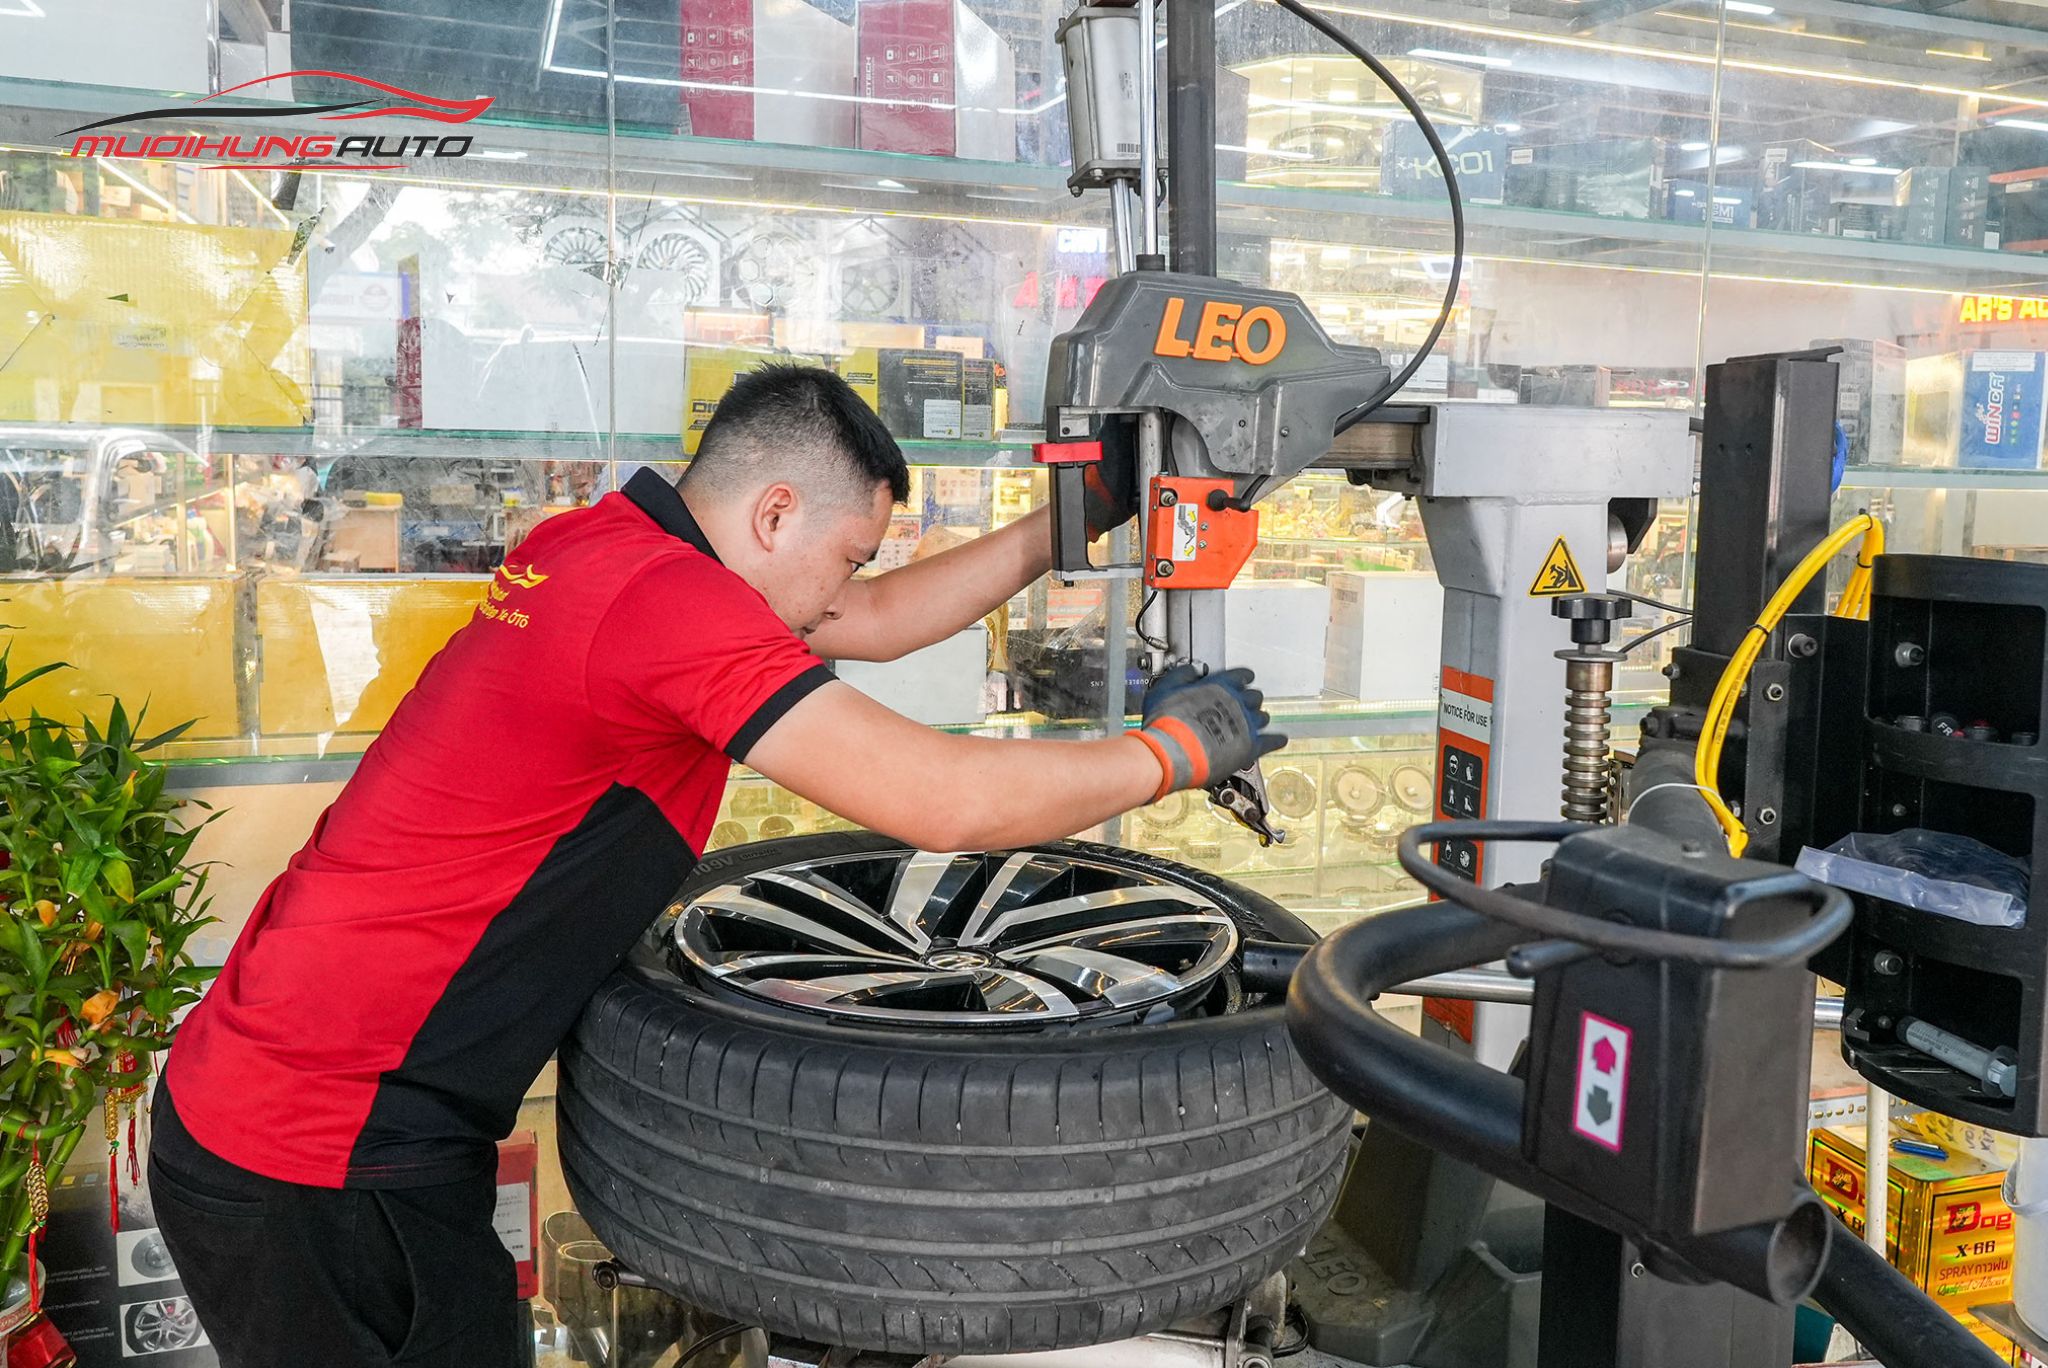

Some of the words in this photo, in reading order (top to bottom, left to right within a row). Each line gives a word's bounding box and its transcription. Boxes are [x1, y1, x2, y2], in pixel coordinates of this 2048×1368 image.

[1154, 297, 1287, 365] LEO
[1444, 702, 1463, 719] NOTICE
[1464, 709, 1475, 724] FOR
[1475, 713, 1488, 728] USE
[1937, 722, 1953, 736] FR
[1944, 1201, 2012, 1235] Dog
[1956, 1240, 1996, 1258] X-66
[1939, 1263, 1975, 1281] SPRAY
